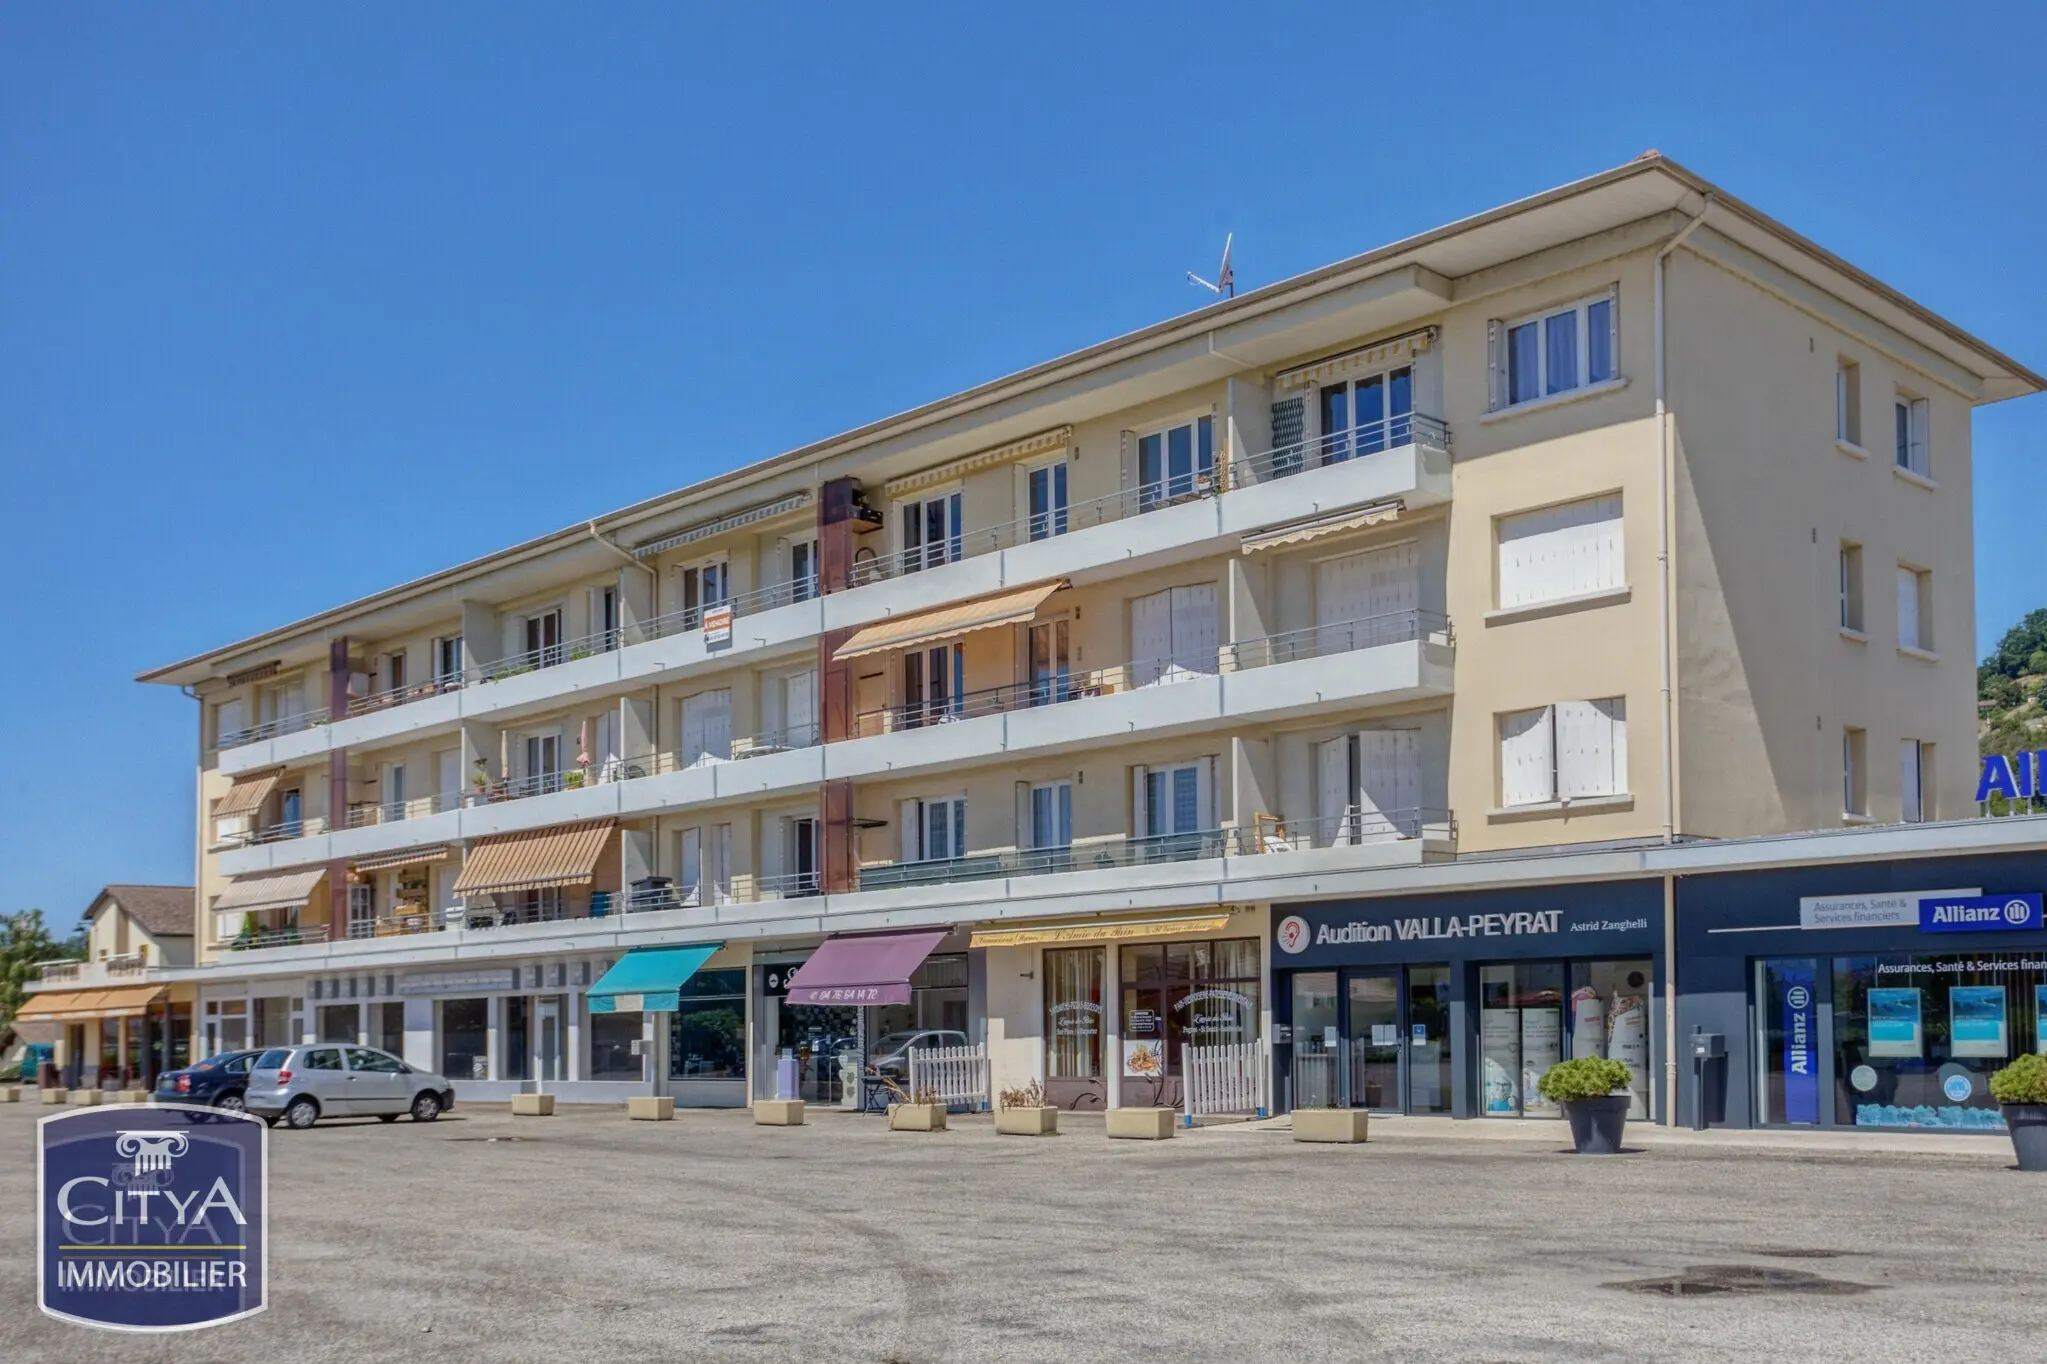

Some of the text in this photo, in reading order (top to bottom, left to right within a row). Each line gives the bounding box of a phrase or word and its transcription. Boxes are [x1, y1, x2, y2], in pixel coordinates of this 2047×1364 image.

[1869, 899, 1898, 909] Santé
[1898, 899, 1907, 908] &
[1814, 911, 1900, 923] Services financiers
[1932, 905, 2000, 923] Allianz
[1316, 910, 1648, 944] Audition VALLA-PEYRAT Astrid Zanghelli
[1878, 958, 2047, 974] Assurances, Santé & Services finan
[1790, 1012, 1808, 1075] Allianz
